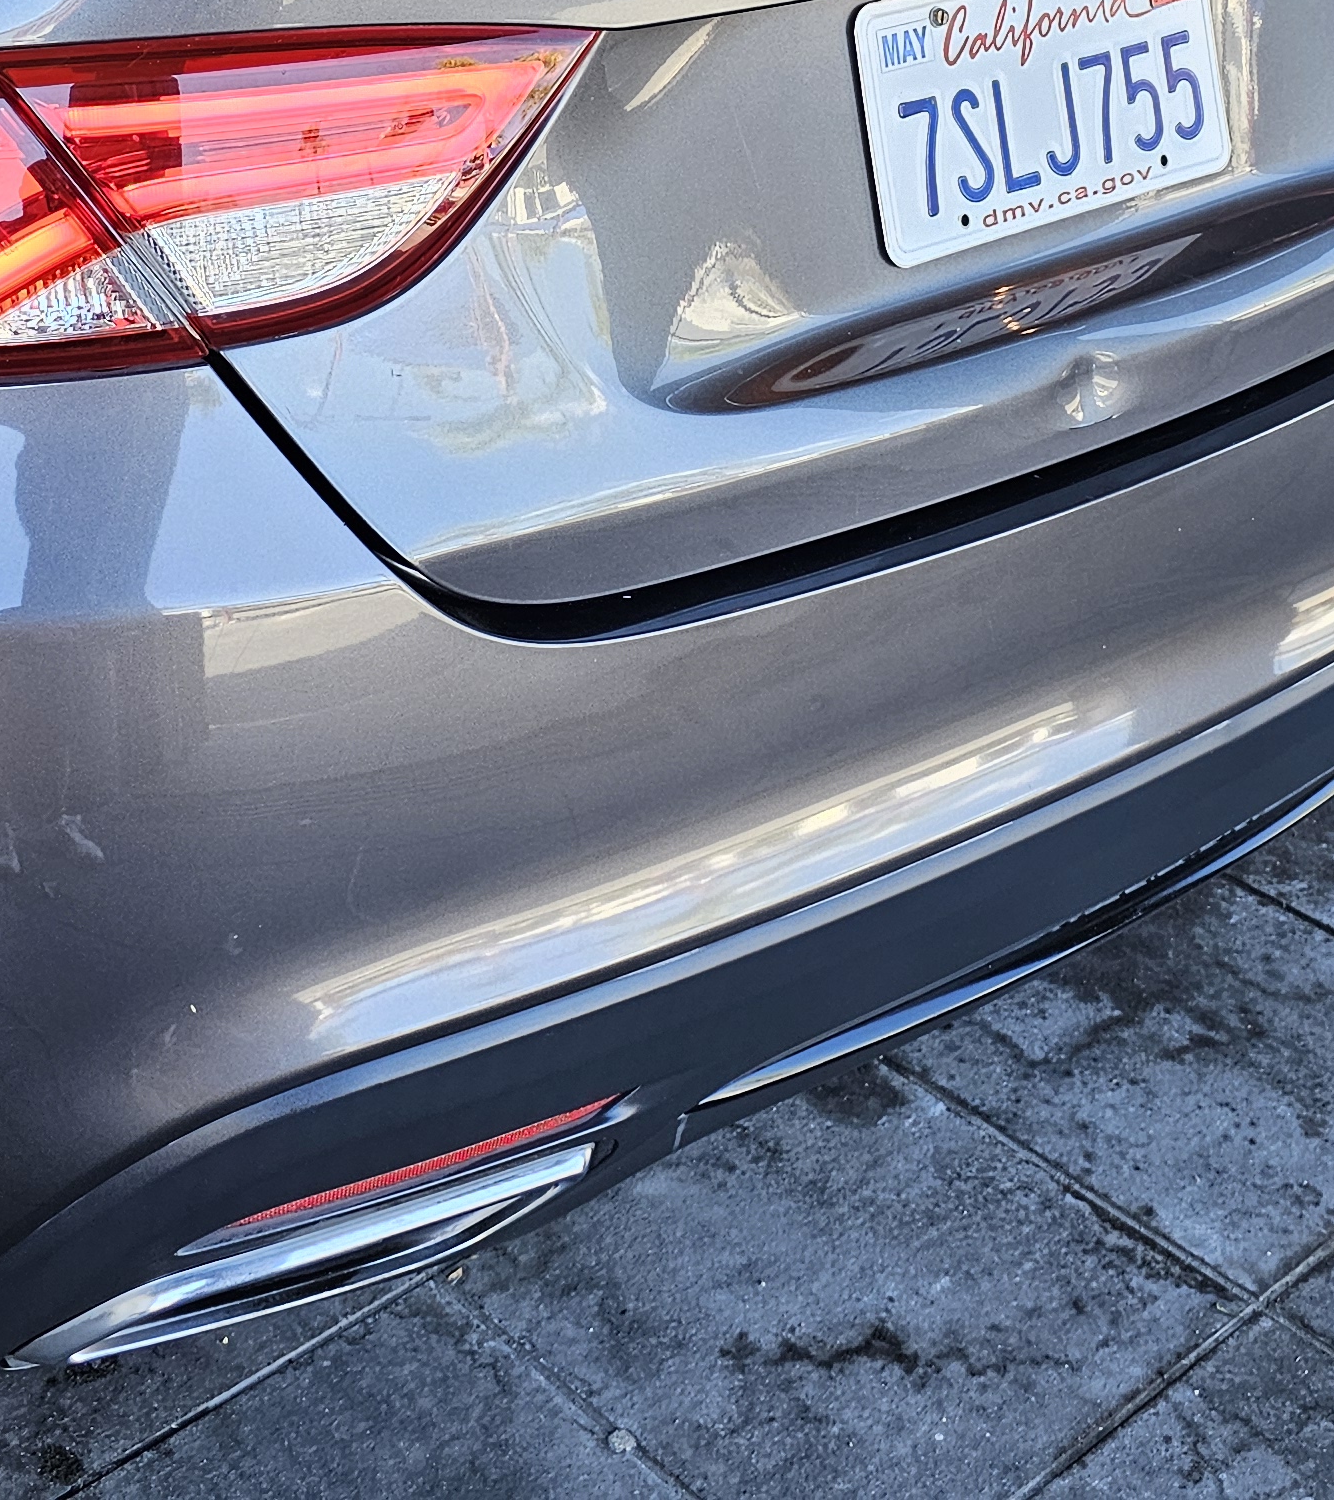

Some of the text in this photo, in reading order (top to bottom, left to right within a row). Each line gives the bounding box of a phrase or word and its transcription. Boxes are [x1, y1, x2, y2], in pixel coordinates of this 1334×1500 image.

[881, 25, 928, 69] MAY
[898, 29, 1205, 218] 7SLJ755
[982, 164, 1153, 229] dmv.ca.gov
